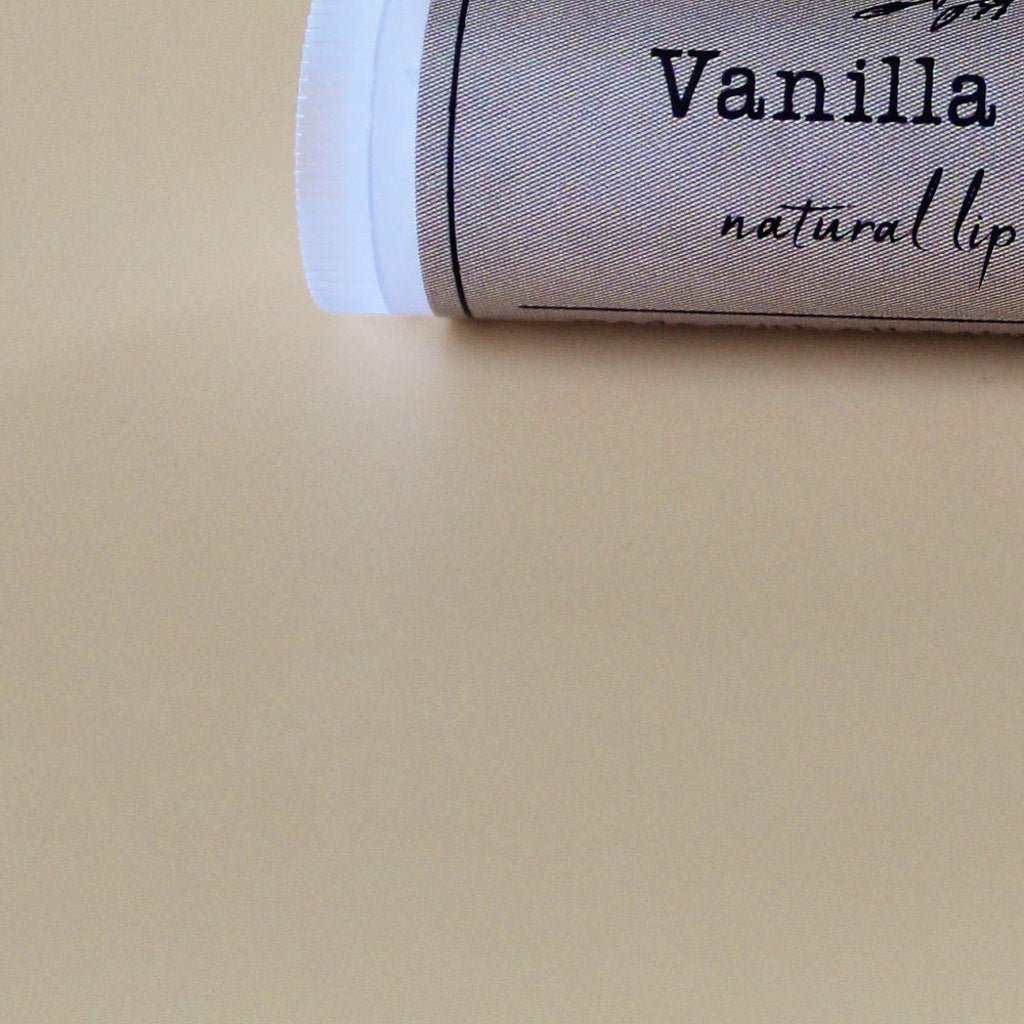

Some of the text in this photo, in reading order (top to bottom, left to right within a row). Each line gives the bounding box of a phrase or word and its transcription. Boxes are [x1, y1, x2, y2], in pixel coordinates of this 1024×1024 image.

[650, 46, 998, 129] Vanilla
[720, 166, 944, 252] natural
[951, 167, 1018, 291] lip
